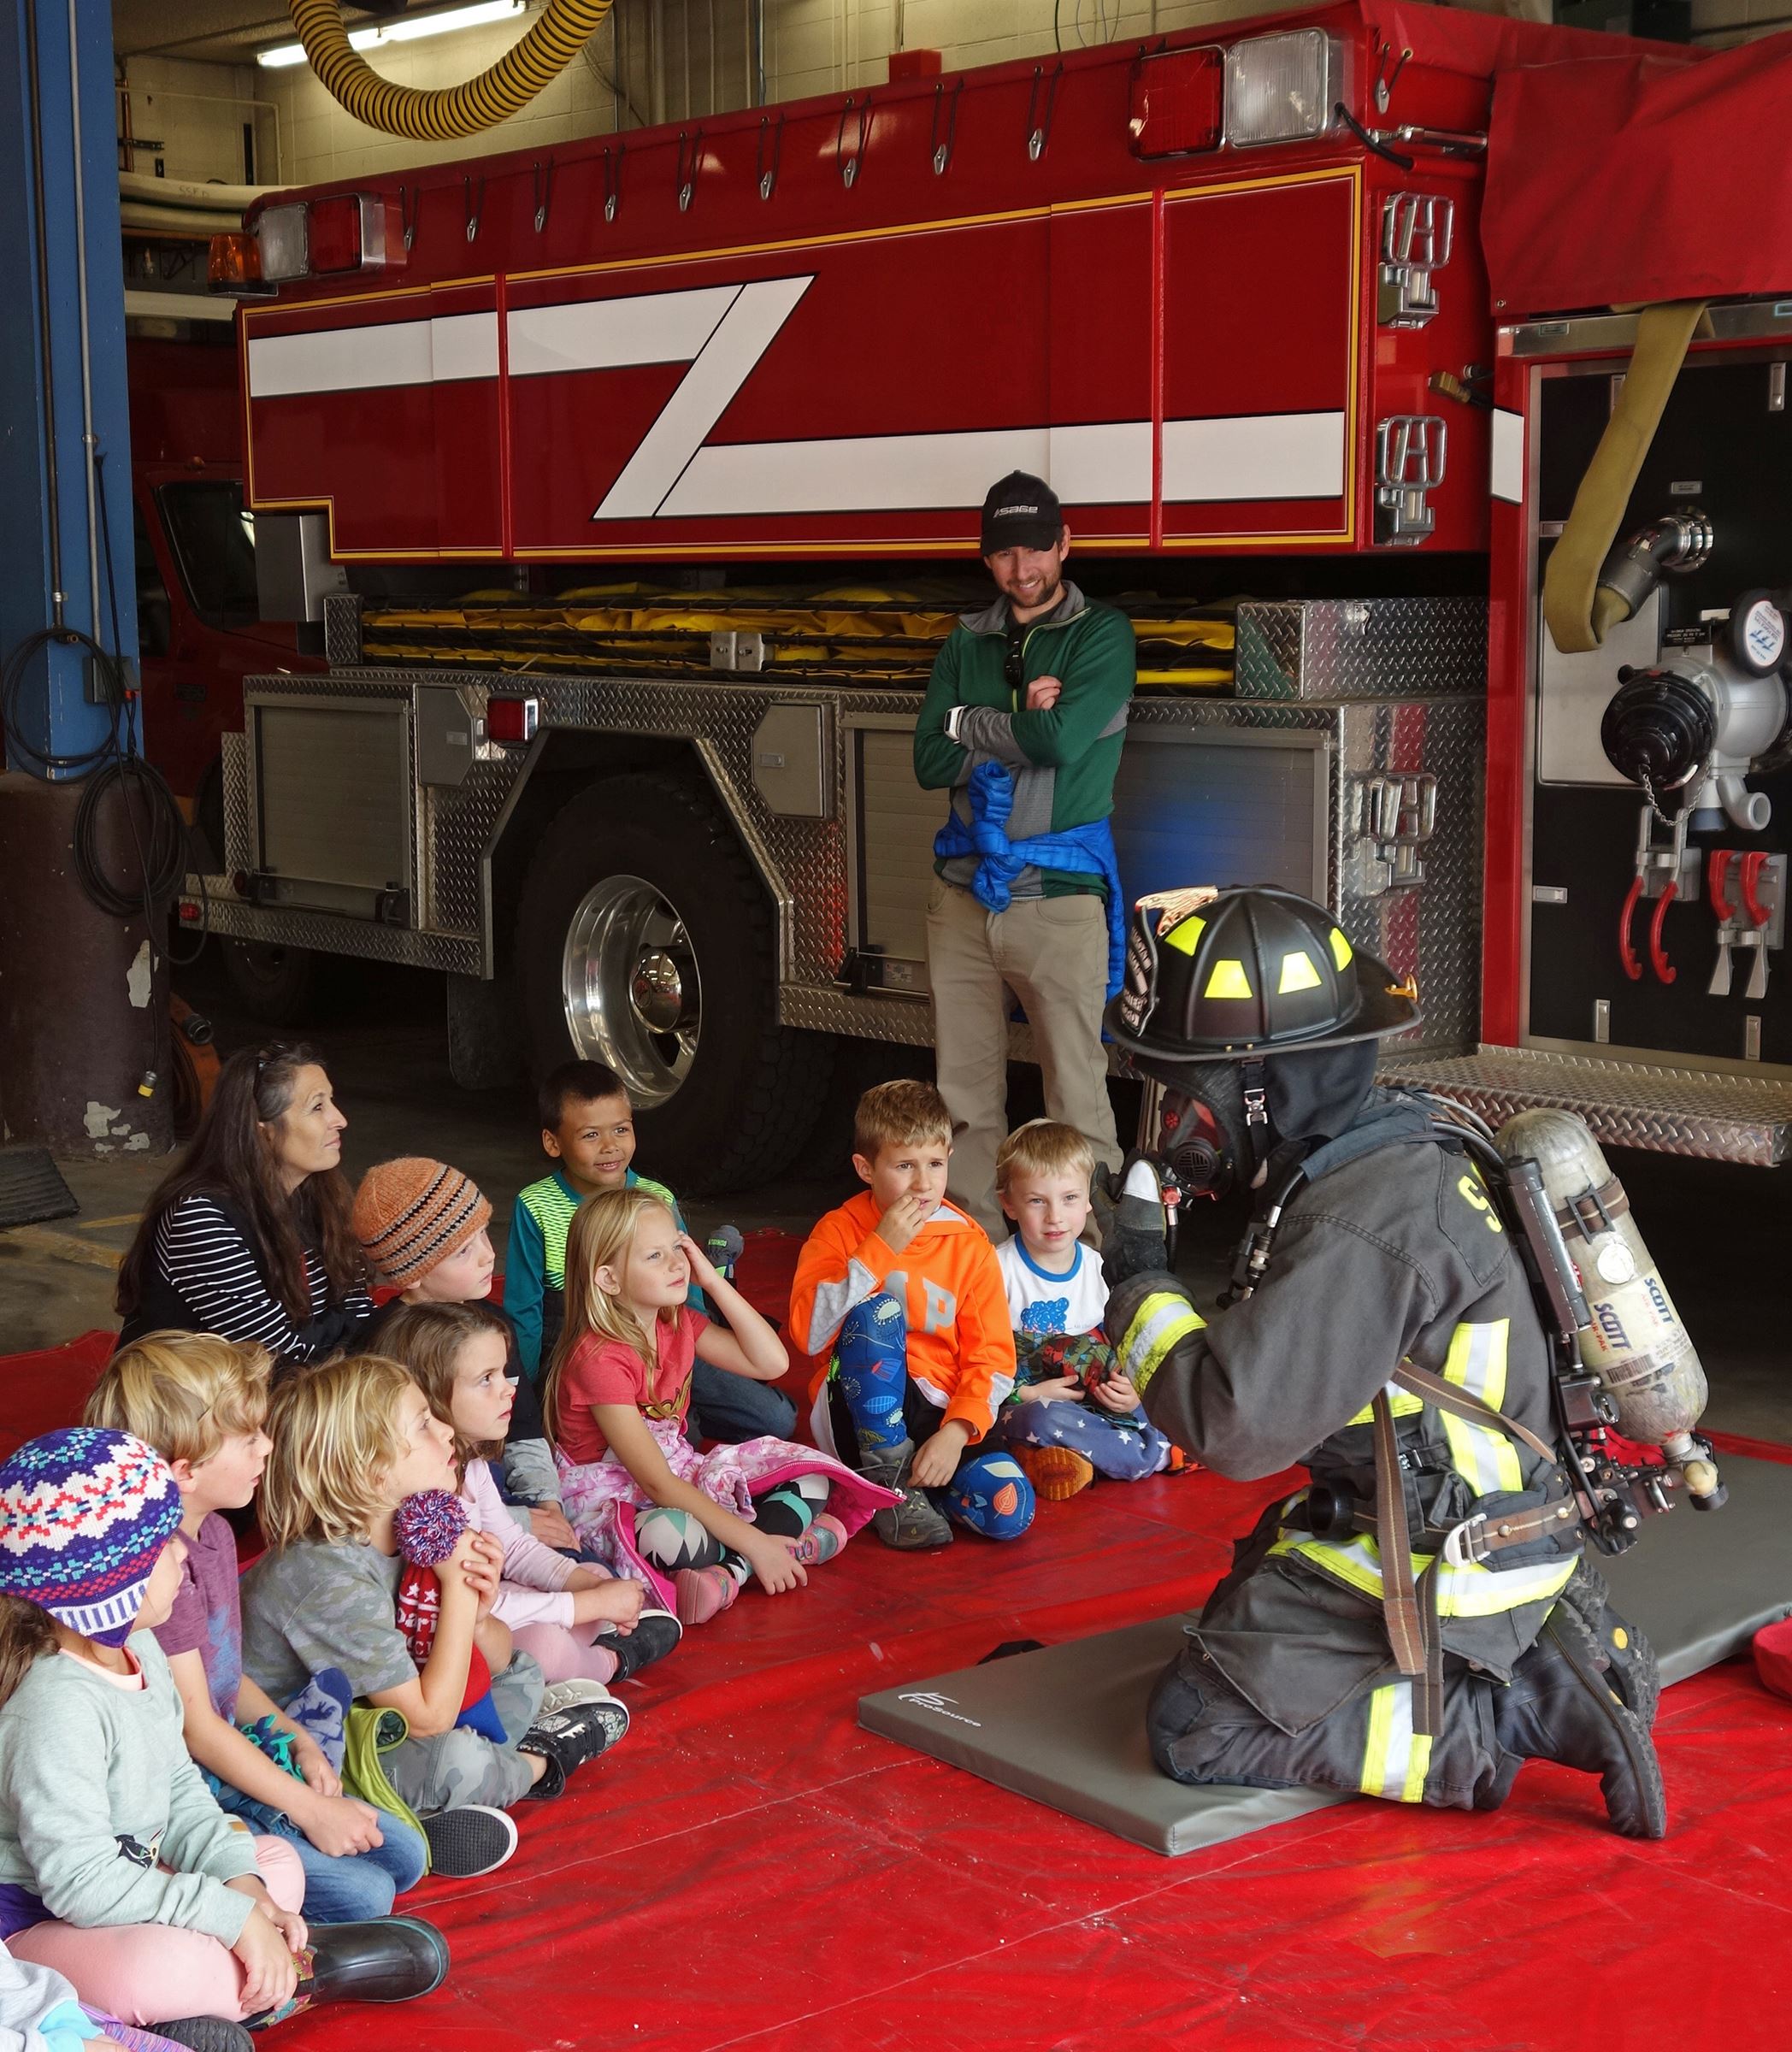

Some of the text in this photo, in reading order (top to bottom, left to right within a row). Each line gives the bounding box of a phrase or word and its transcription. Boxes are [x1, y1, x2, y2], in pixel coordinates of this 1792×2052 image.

[1456, 1162, 1503, 1233] S
[1644, 1277, 1675, 1324] SCOTT
[1594, 1303, 1634, 1351] SCOTT
[908, 1698, 981, 1728] ProSource
